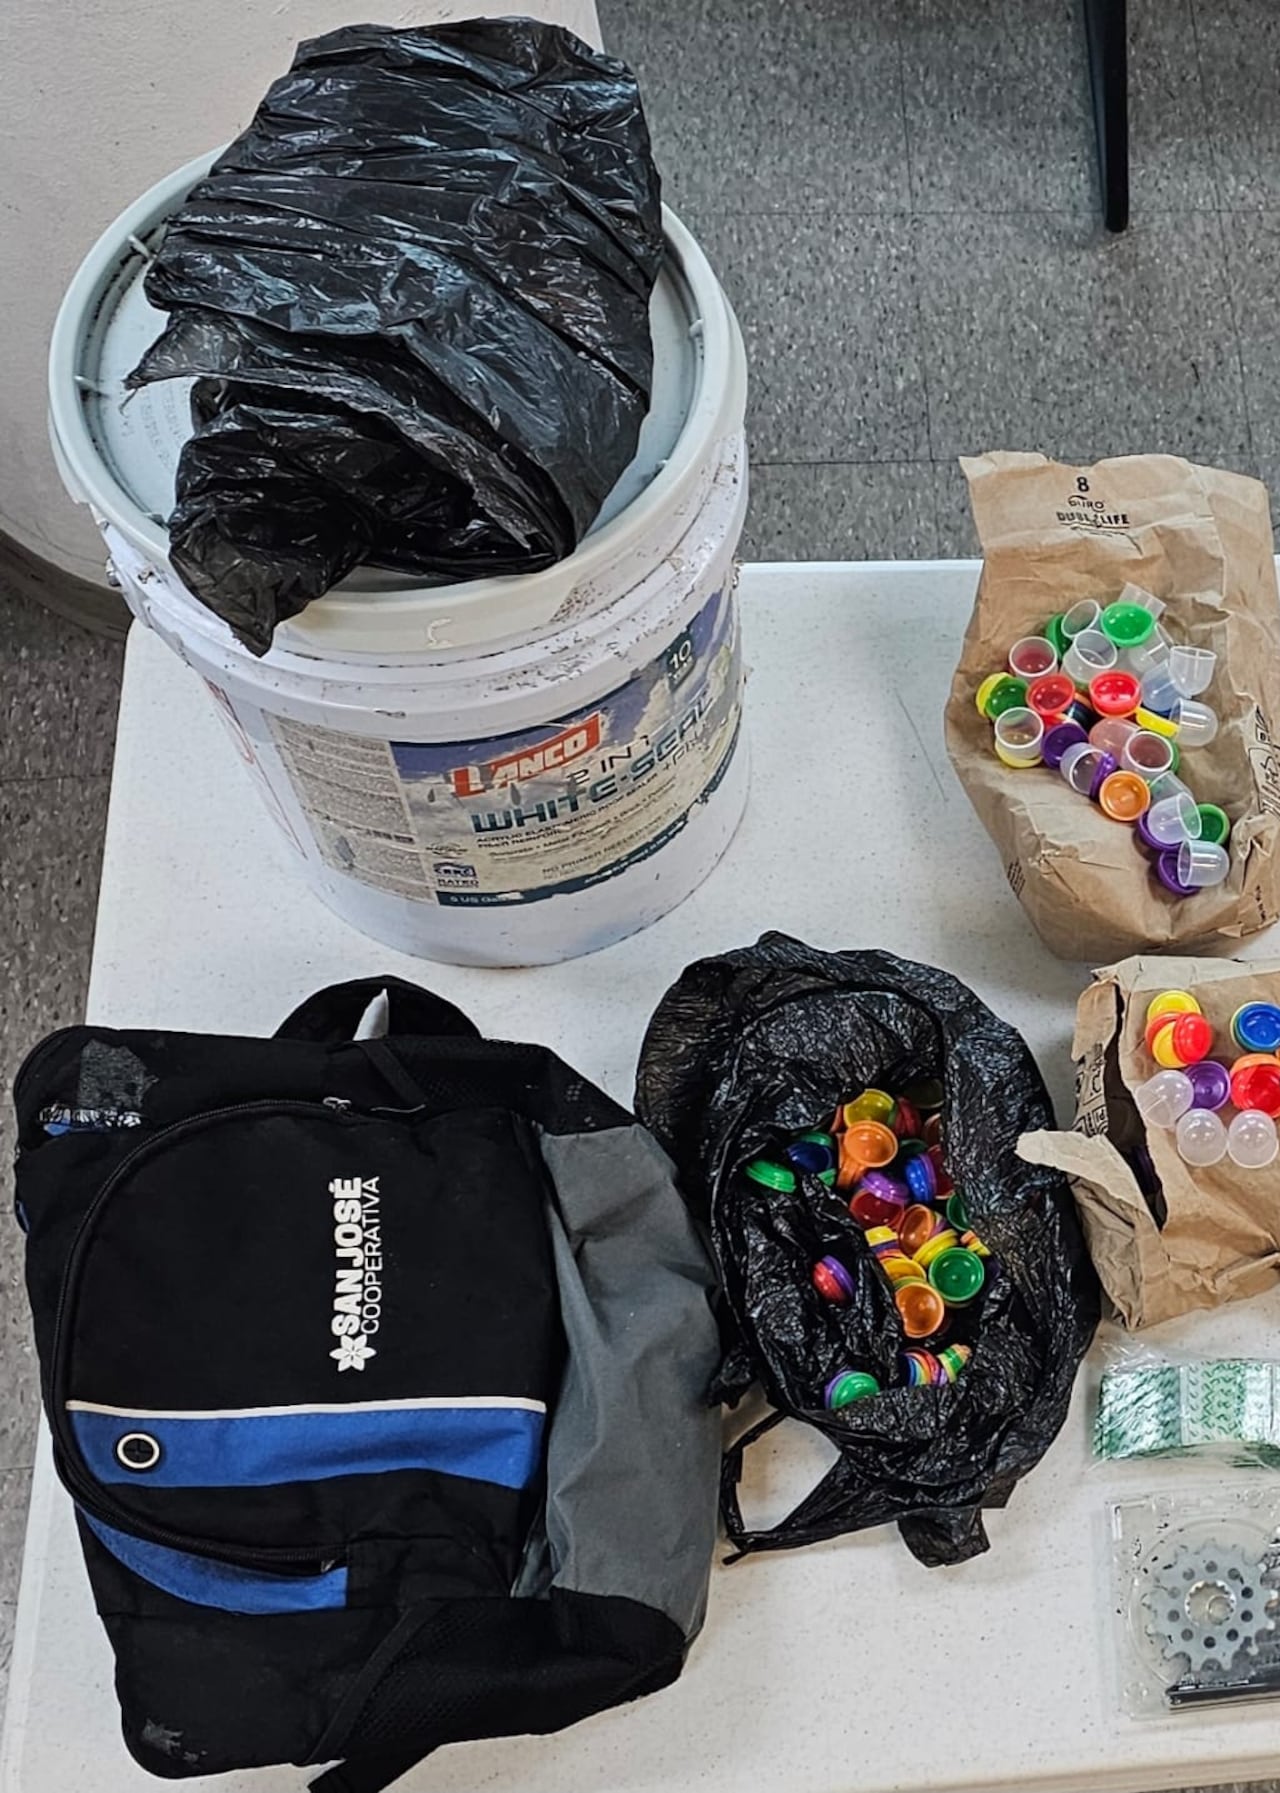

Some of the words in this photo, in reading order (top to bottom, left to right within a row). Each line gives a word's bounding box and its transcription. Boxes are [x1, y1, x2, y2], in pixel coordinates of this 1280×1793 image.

[1077, 476, 1090, 492] 8
[670, 639, 691, 669] 10
[456, 727, 589, 796] LANCO
[471, 690, 714, 833] WHITE-SEAL
[600, 746, 632, 773] IN
[328, 1177, 365, 1267] JOSÉ
[361, 1176, 383, 1334] COOPERATIVA
[331, 1269, 364, 1336] SAN
